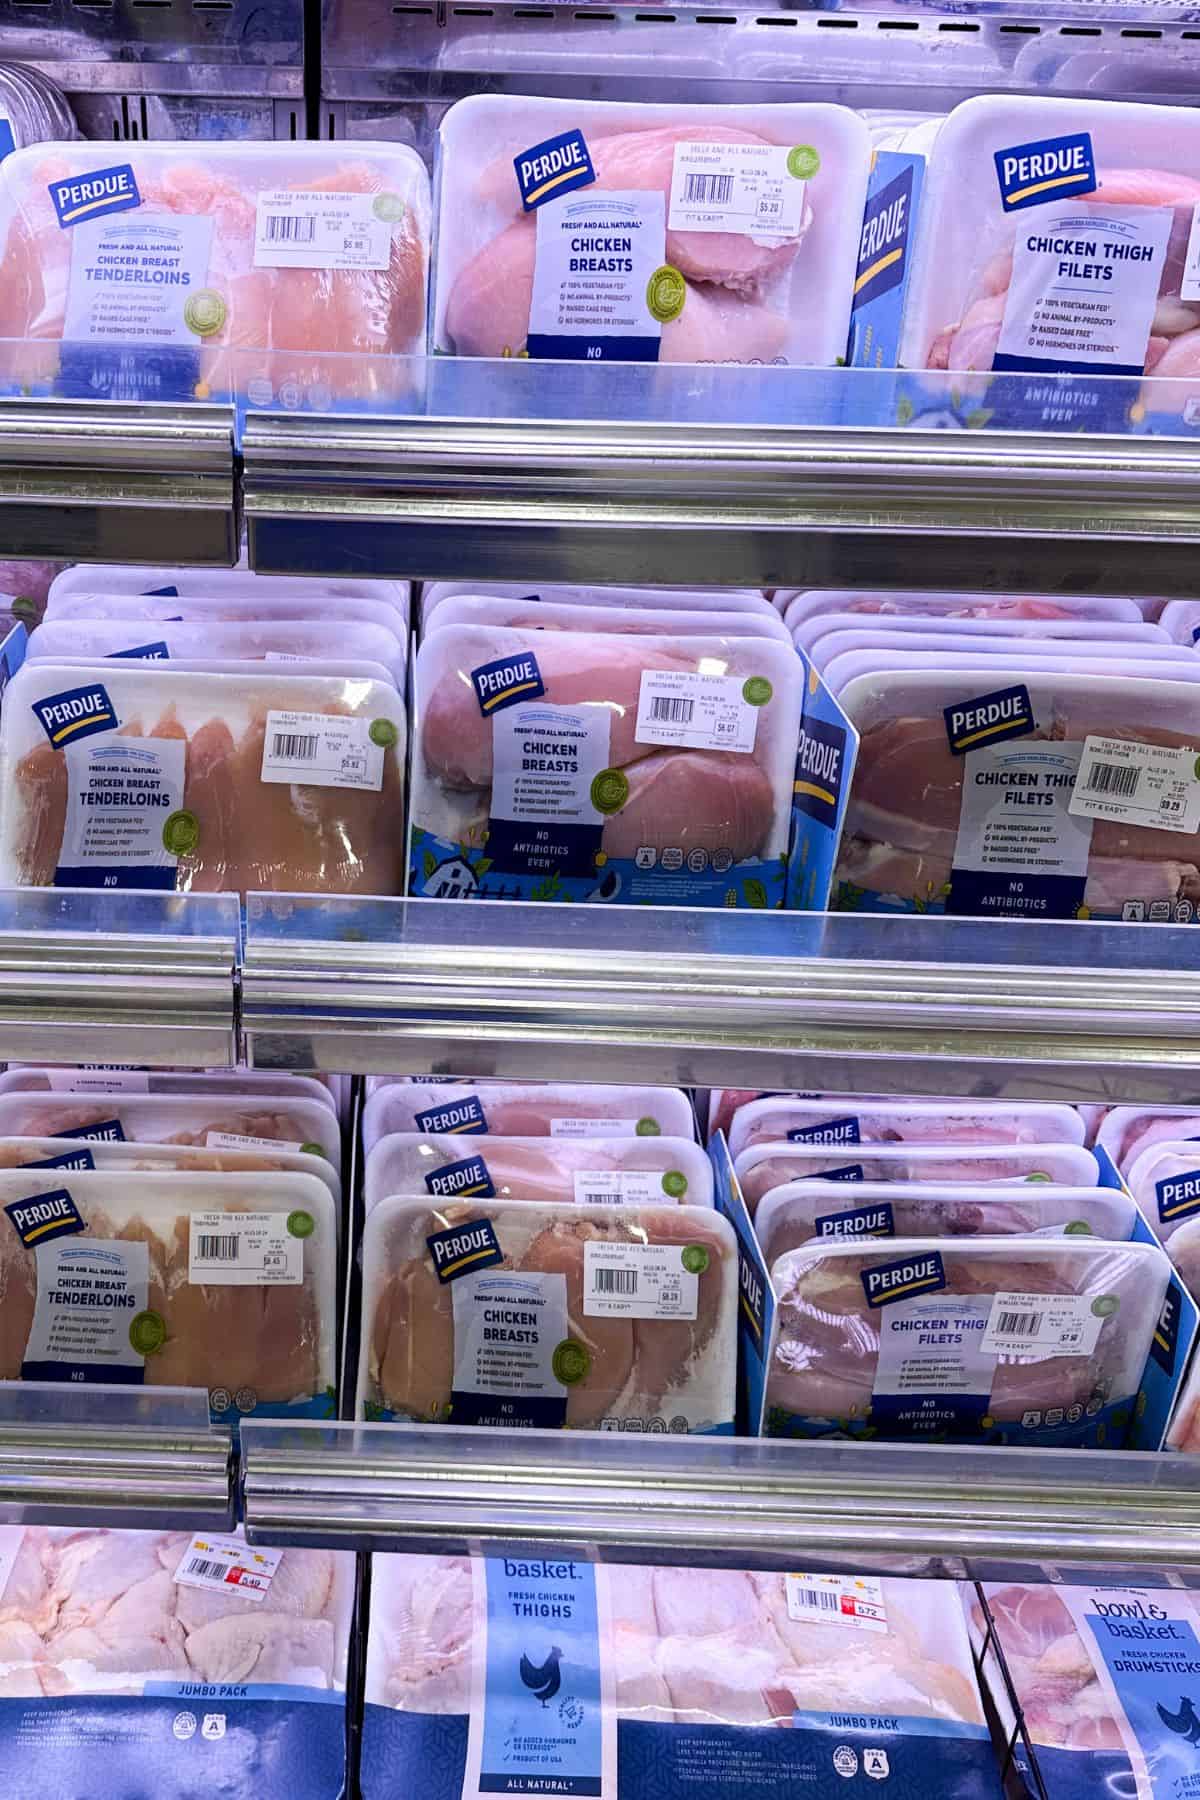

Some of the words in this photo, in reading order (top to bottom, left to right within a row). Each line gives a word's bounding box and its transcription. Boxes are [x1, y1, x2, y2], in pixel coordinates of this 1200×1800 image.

[521, 142, 584, 188] PERDUE
[1003, 146, 1085, 185] PERDUE
[57, 173, 130, 208] PERDUE
[860, 194, 907, 262] ERDUE
[120, 243, 134, 251] AND
[571, 238, 631, 252] CHICKEN
[1027, 236, 1096, 257] CHICKEN
[1103, 244, 1155, 261] THIGH
[97, 256, 138, 265] CHICKEN
[141, 258, 180, 267] BREAST
[569, 258, 633, 272] BREASTS
[85, 269, 191, 285] TENDERLOINS
[1058, 262, 1113, 280] FILETS
[1060, 300, 1096, 310] VEGETARIAN
[587, 347, 601, 358] NO
[1024, 387, 1099, 406] ANTIBIOTICS
[478, 661, 535, 697] PERDUE
[41, 694, 105, 729] PERDUE
[952, 696, 1023, 735] PERDUE
[523, 742, 578, 756] CHICKEN
[798, 728, 840, 783] PERDUE
[522, 759, 578, 773] BREASTS
[89, 778, 123, 788] CHICKEN
[127, 780, 160, 789] BREAST
[975, 772, 1038, 786] CHICKEN
[1044, 774, 1078, 787] THIG
[80, 792, 170, 807] TENDERLOINS
[1004, 792, 1054, 806] FILETS
[536, 831, 549, 840] NO
[513, 843, 569, 855] ANTIBIOTICS
[104, 876, 118, 886] NO
[1009, 882, 1023, 892] NO
[981, 896, 1047, 910] ANTIBIOTICS
[422, 1104, 479, 1133] PERDUE
[432, 1164, 483, 1195] PERDUE
[13, 1198, 71, 1230] PERDUE
[822, 1212, 886, 1236] PERDUE
[434, 1229, 490, 1264] PERDUE
[869, 1260, 936, 1292] PERDUE
[57, 1279, 92, 1288] CHICKEN
[95, 1280, 127, 1291] BREAST
[742, 1259, 762, 1317] DUE
[48, 1292, 136, 1307] TENDERLOINS
[484, 1310, 537, 1325] CHICKEN
[891, 1320, 948, 1331] CHICKEN
[483, 1328, 539, 1343] BREASTS
[918, 1334, 963, 1345] FILETS
[72, 1372, 84, 1381] NO
[501, 1404, 513, 1413] NO
[922, 1400, 935, 1408] NO
[898, 1411, 955, 1420] ANTIBIOTICS
[503, 1559, 577, 1580] basket
[508, 1591, 536, 1601] FRESH
[538, 1592, 575, 1602] CHICKEN
[512, 1603, 572, 1618] THIGHS
[1090, 1599, 1149, 1620] bowl
[1149, 1604, 1168, 1621] &
[1101, 1617, 1180, 1640] basket
[1121, 1650, 1147, 1658] FRESH
[1149, 1651, 1187, 1659] CHICKEN
[1113, 1660, 1200, 1673] DRUMSTICKS
[178, 1685, 216, 1697] JUMBO
[220, 1686, 248, 1697] PACK
[209, 1721, 218, 1731] A
[830, 1716, 867, 1728] JUMBO
[870, 1719, 899, 1730] PACK
[541, 1755, 549, 1763] OF
[872, 1757, 882, 1769] A
[507, 1780, 524, 1789] ALL
